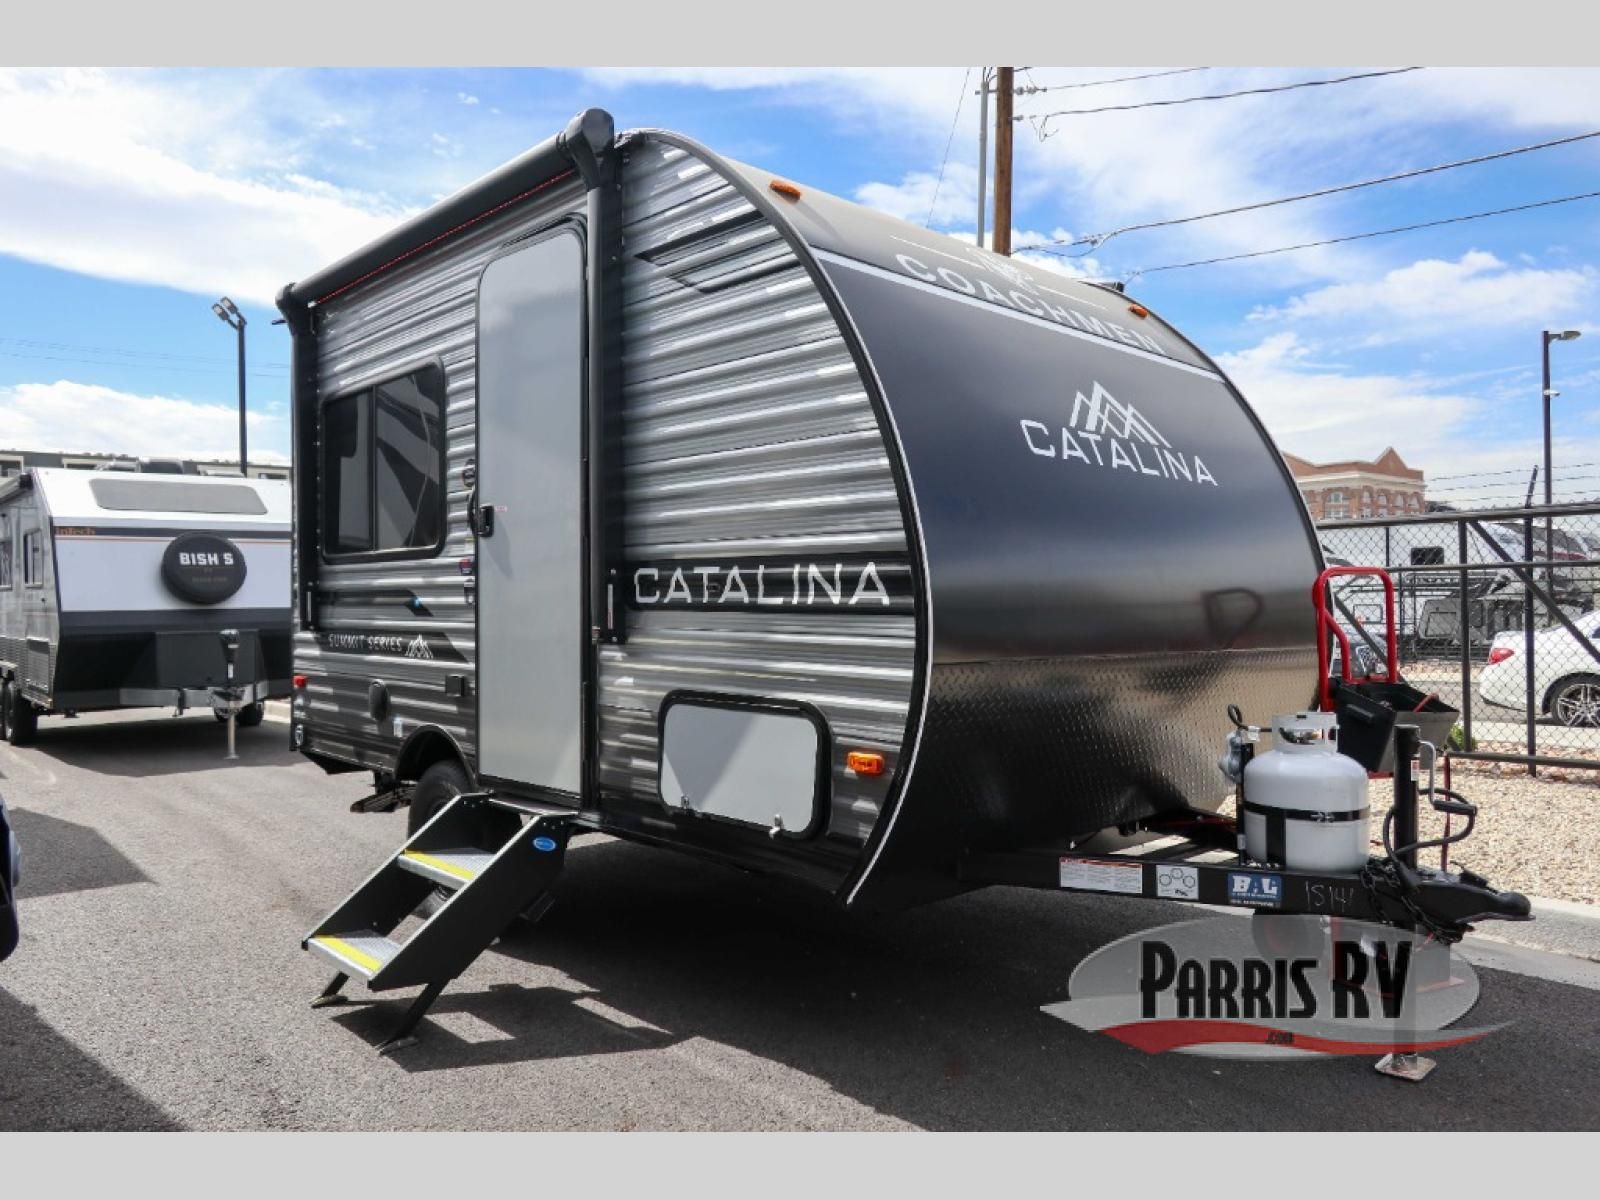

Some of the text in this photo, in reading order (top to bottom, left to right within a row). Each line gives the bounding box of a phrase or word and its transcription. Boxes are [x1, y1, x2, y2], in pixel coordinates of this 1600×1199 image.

[895, 254, 1166, 354] COACHMEN
[1019, 419, 1219, 487] CATALINA
[633, 561, 891, 606] CATALINA
[328, 633, 402, 652] SUMMIT SERIES
